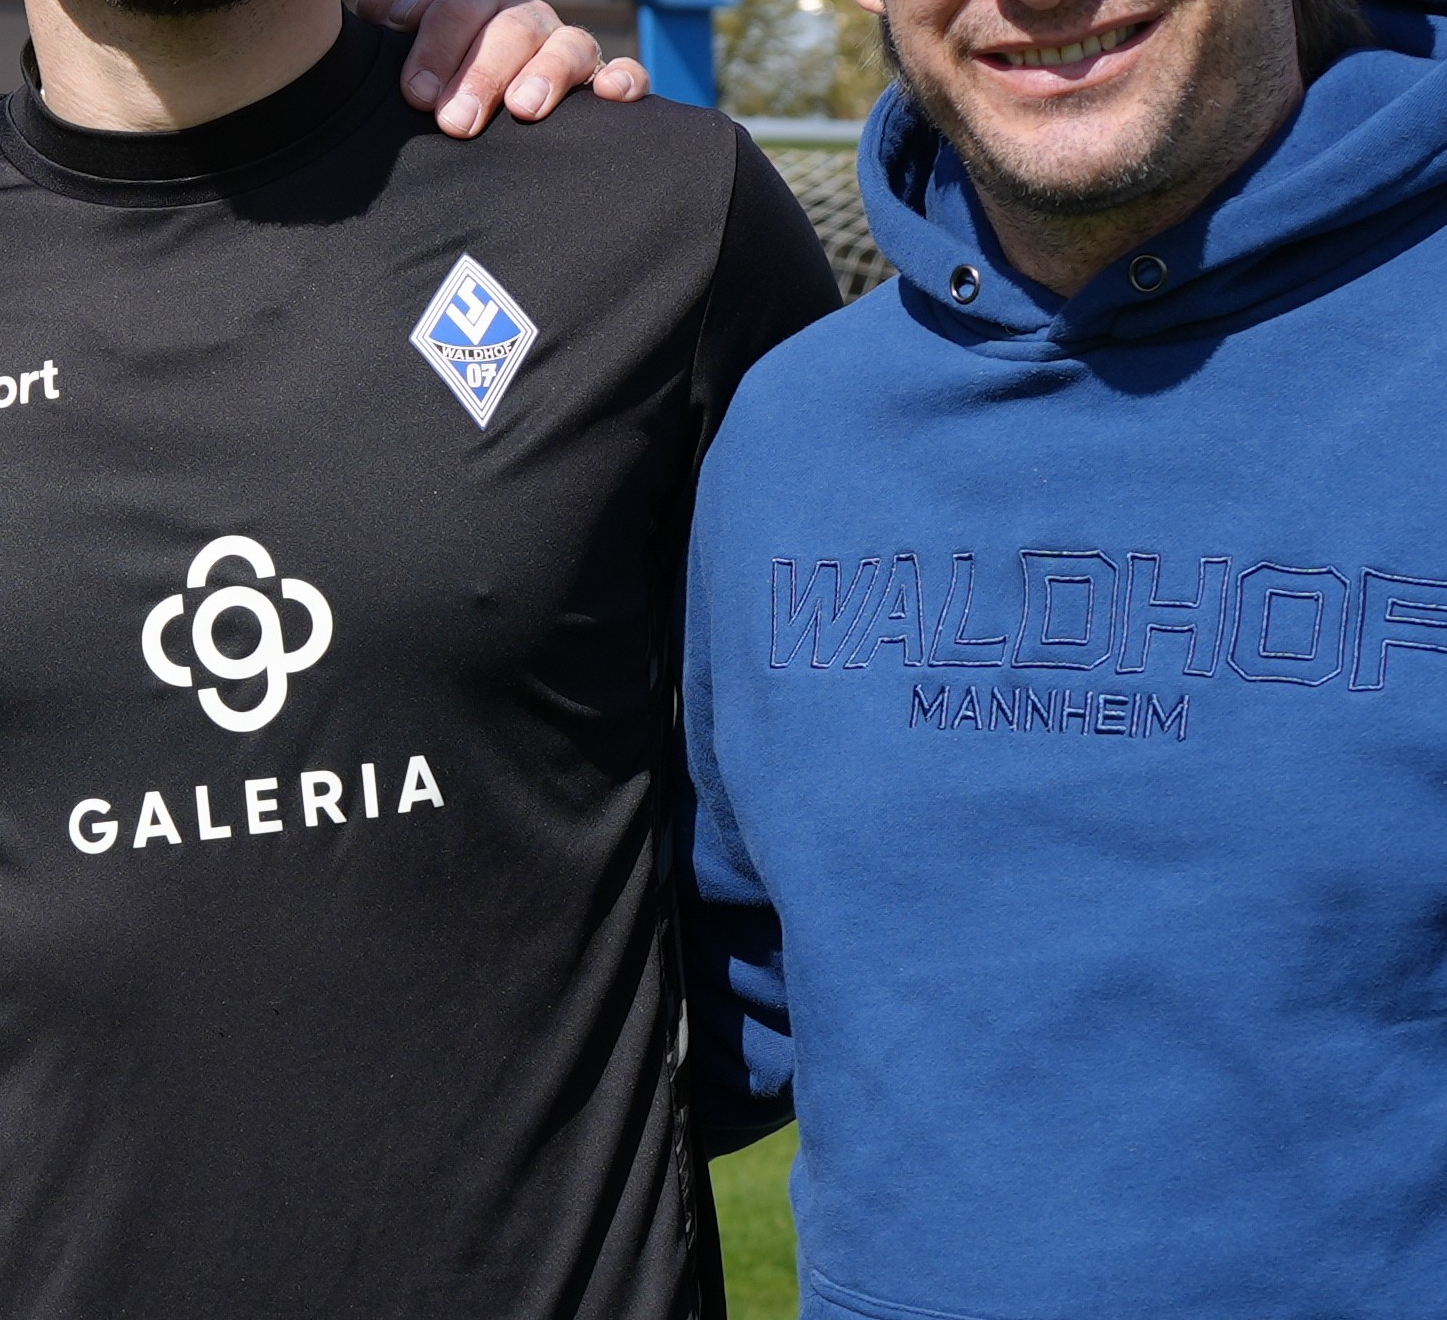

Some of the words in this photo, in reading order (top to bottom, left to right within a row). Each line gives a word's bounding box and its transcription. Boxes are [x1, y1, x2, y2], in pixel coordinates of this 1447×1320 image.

[442, 341, 513, 361] WALDHOF
[466, 363, 497, 389] 07
[909, 683, 1191, 741] MANNHEIM
[68, 754, 446, 856] GALERIA
